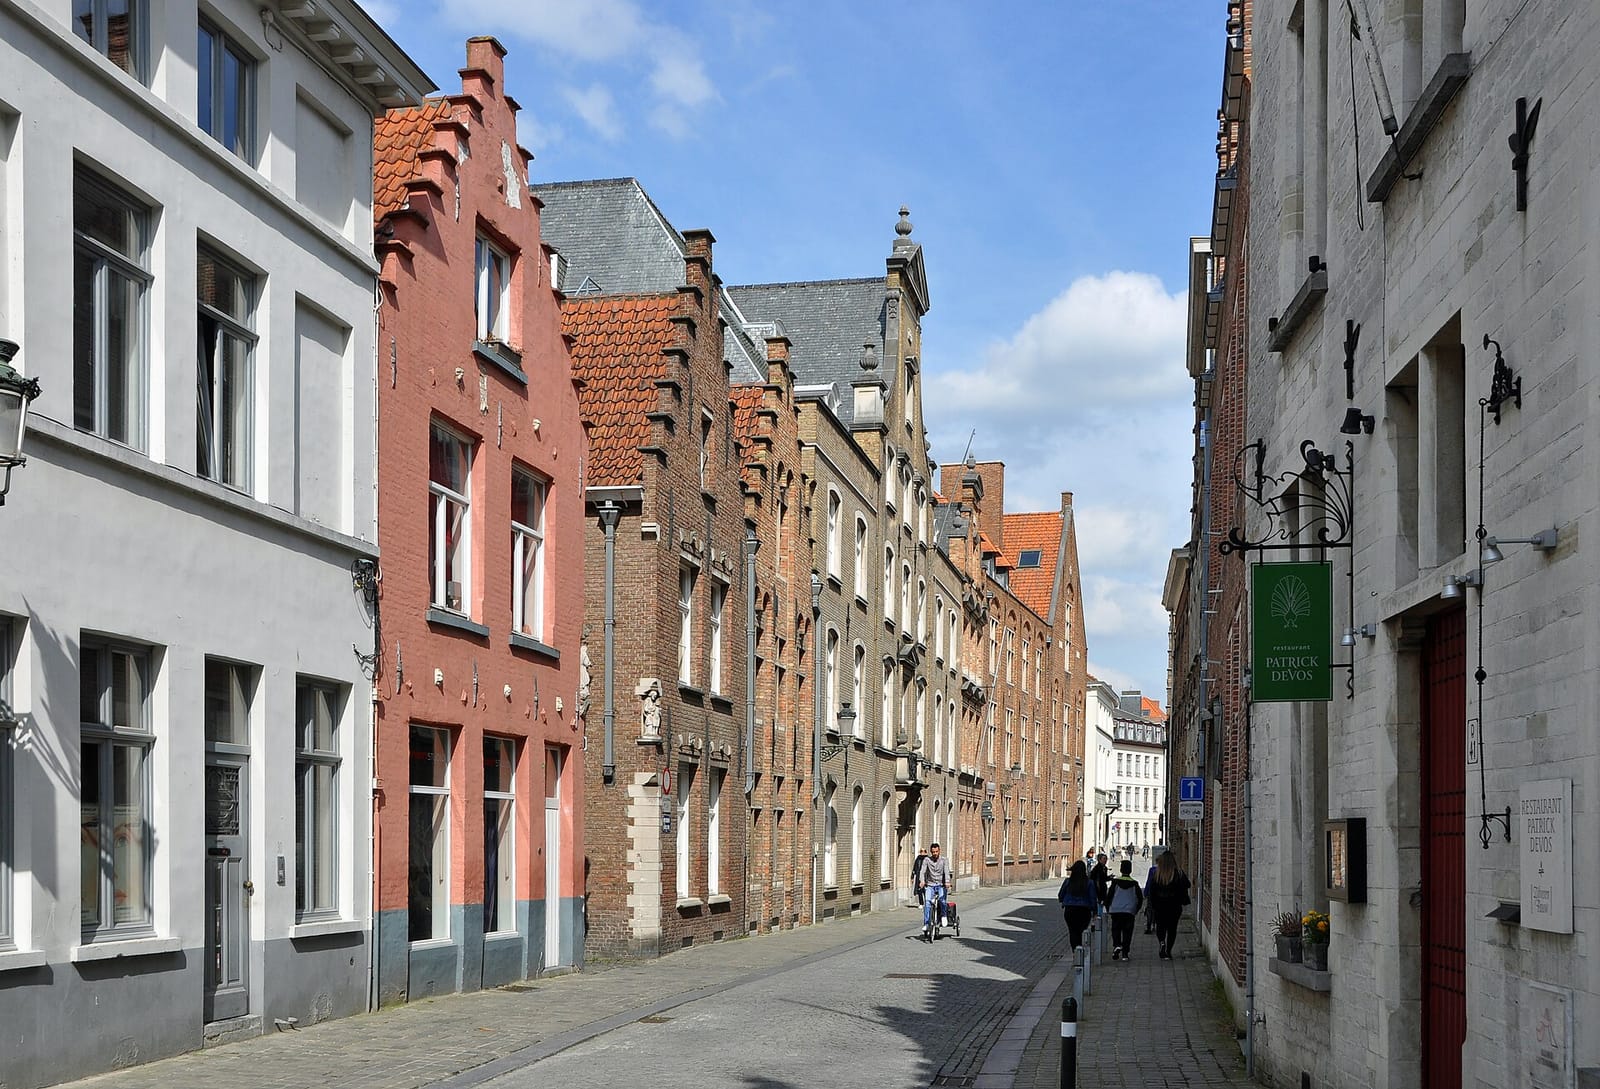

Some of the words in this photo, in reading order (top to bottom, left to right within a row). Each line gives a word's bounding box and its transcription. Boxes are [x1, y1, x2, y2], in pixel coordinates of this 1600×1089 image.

[1266, 656, 1319, 669] PATRICK
[1271, 669, 1313, 681] DEVOS
[1521, 797, 1562, 815] RESTAURANT
[1527, 817, 1556, 834] PATRICK
[1530, 836, 1553, 853] DEVOS
